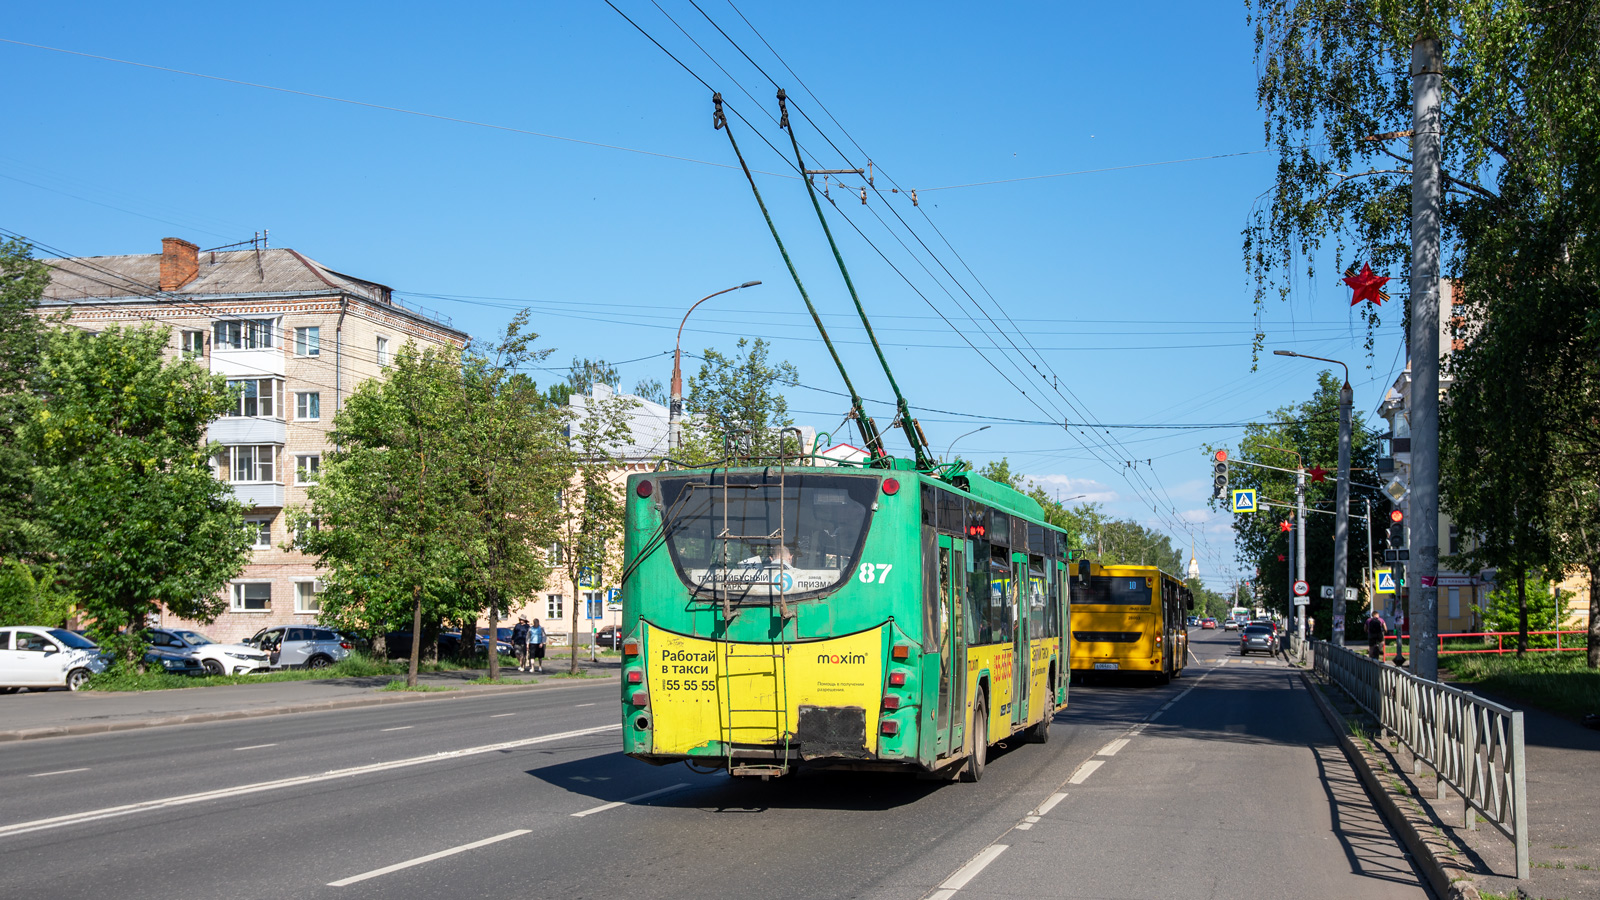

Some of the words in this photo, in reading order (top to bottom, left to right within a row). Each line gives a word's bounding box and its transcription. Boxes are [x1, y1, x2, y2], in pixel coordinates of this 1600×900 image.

[697, 574, 769, 582] ТРОЛЛЙБУСНЫЙ
[859, 562, 892, 584] 87
[1129, 581, 1137, 590] 10
[1326, 588, 1352, 598] СП
[662, 649, 716, 662] Работай
[817, 651, 866, 664] maxim
[662, 665, 669, 674] в
[672, 665, 708, 674] такси
